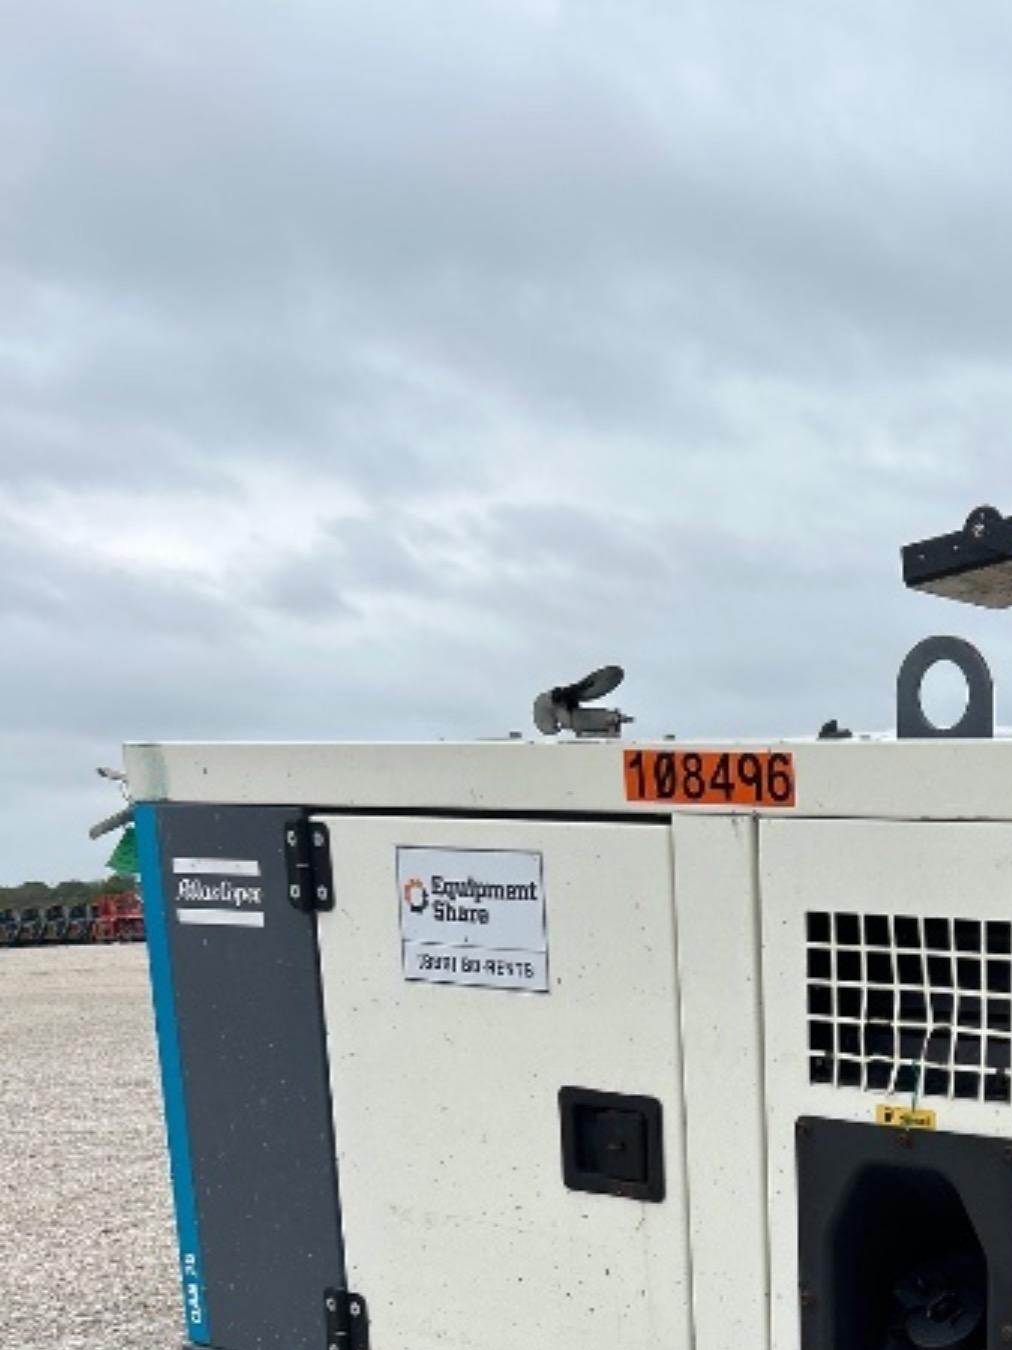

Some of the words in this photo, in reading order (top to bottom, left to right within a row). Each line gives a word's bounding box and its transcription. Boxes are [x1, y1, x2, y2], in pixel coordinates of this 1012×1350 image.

[629, 751, 792, 802] 108496
[431, 876, 538, 903] Equipment
[432, 900, 489, 924] Share
